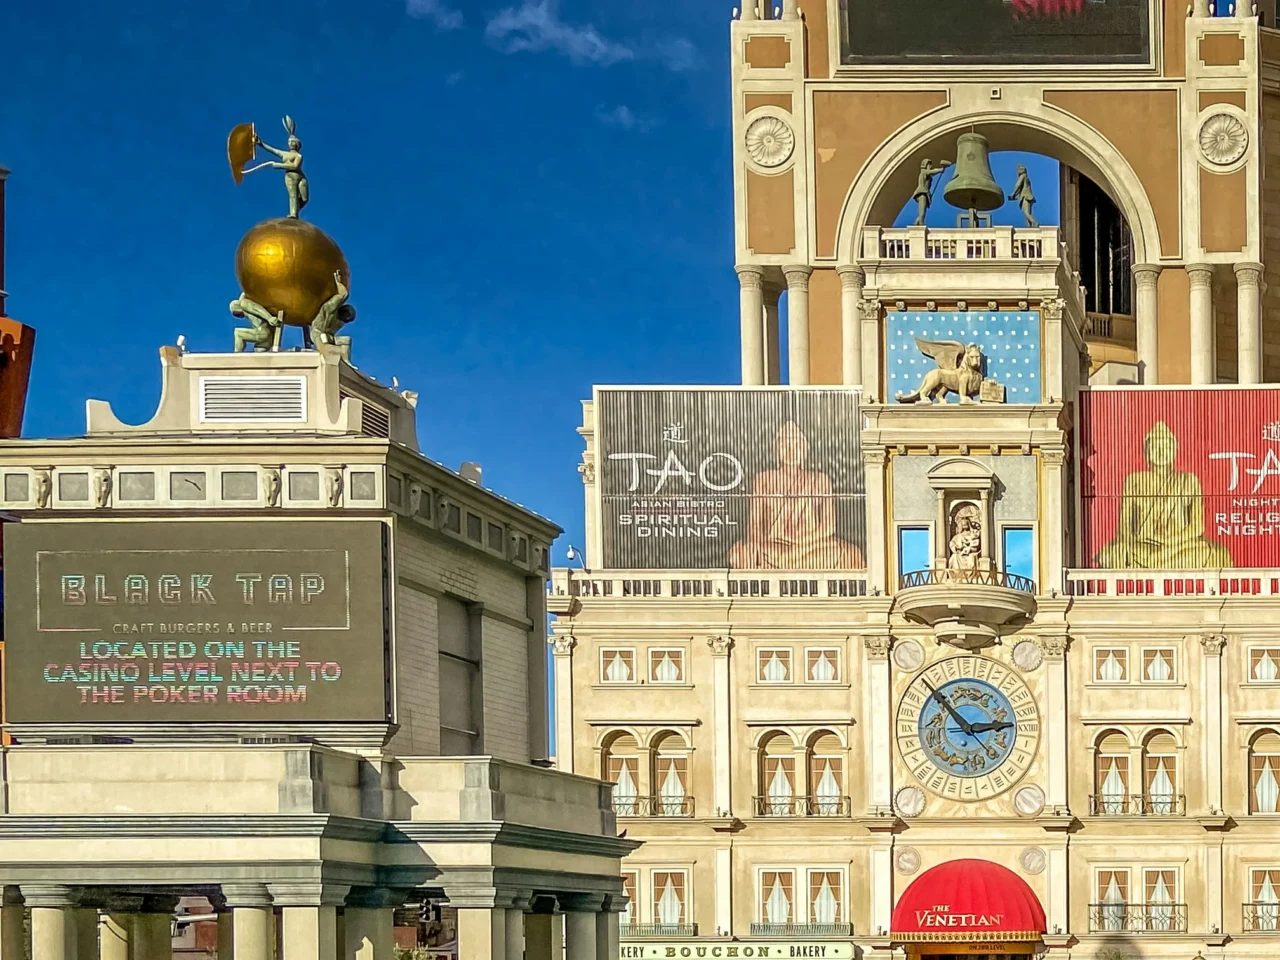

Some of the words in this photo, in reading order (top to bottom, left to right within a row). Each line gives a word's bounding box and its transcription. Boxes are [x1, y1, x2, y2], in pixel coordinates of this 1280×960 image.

[608, 450, 743, 494] TAO
[620, 515, 737, 525] SPIRITUAL
[638, 527, 718, 538] DINING
[61, 574, 216, 605] BLACK
[236, 573, 325, 605] TAP
[113, 623, 154, 634] CRAFT
[160, 623, 220, 634] BURGERS
[227, 623, 235, 633] &
[241, 623, 273, 634] BEER
[80, 641, 197, 659] LOCATED
[204, 641, 244, 659] ON
[252, 641, 300, 658] THE
[44, 663, 140, 683] CASINO
[150, 662, 223, 682] LEVEL
[231, 662, 299, 681] NEXT
[306, 662, 342, 681] TO
[77, 686, 124, 703] THE
[134, 685, 219, 703] POKER
[227, 685, 307, 703] ROOM
[916, 911, 1002, 928] VENETIAN
[621, 947, 644, 958] KERY
[665, 947, 770, 958] BOUCHON
[790, 946, 826, 958] BAKERY
